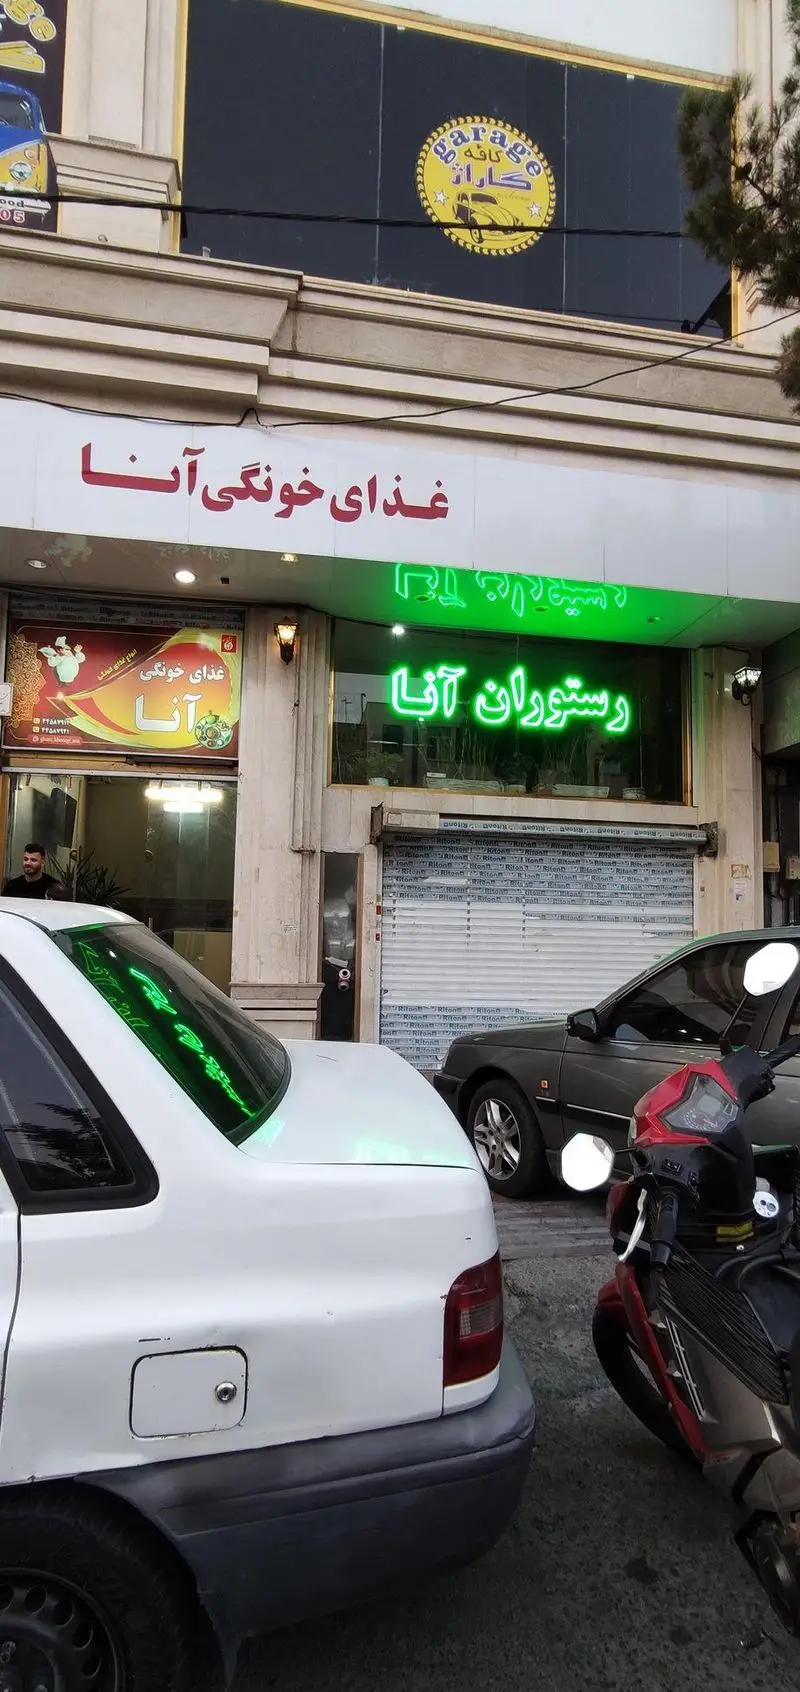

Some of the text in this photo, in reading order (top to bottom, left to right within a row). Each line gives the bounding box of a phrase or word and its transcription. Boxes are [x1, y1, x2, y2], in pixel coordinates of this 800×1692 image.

[432, 126, 542, 177] garage
[464, 144, 501, 163] کافه
[80, 442, 449, 523] غذای خونگی آنا
[139, 661, 226, 685] غذای خونگی
[134, 691, 203, 734] آنا
[391, 665, 631, 732] رستوران آنا
